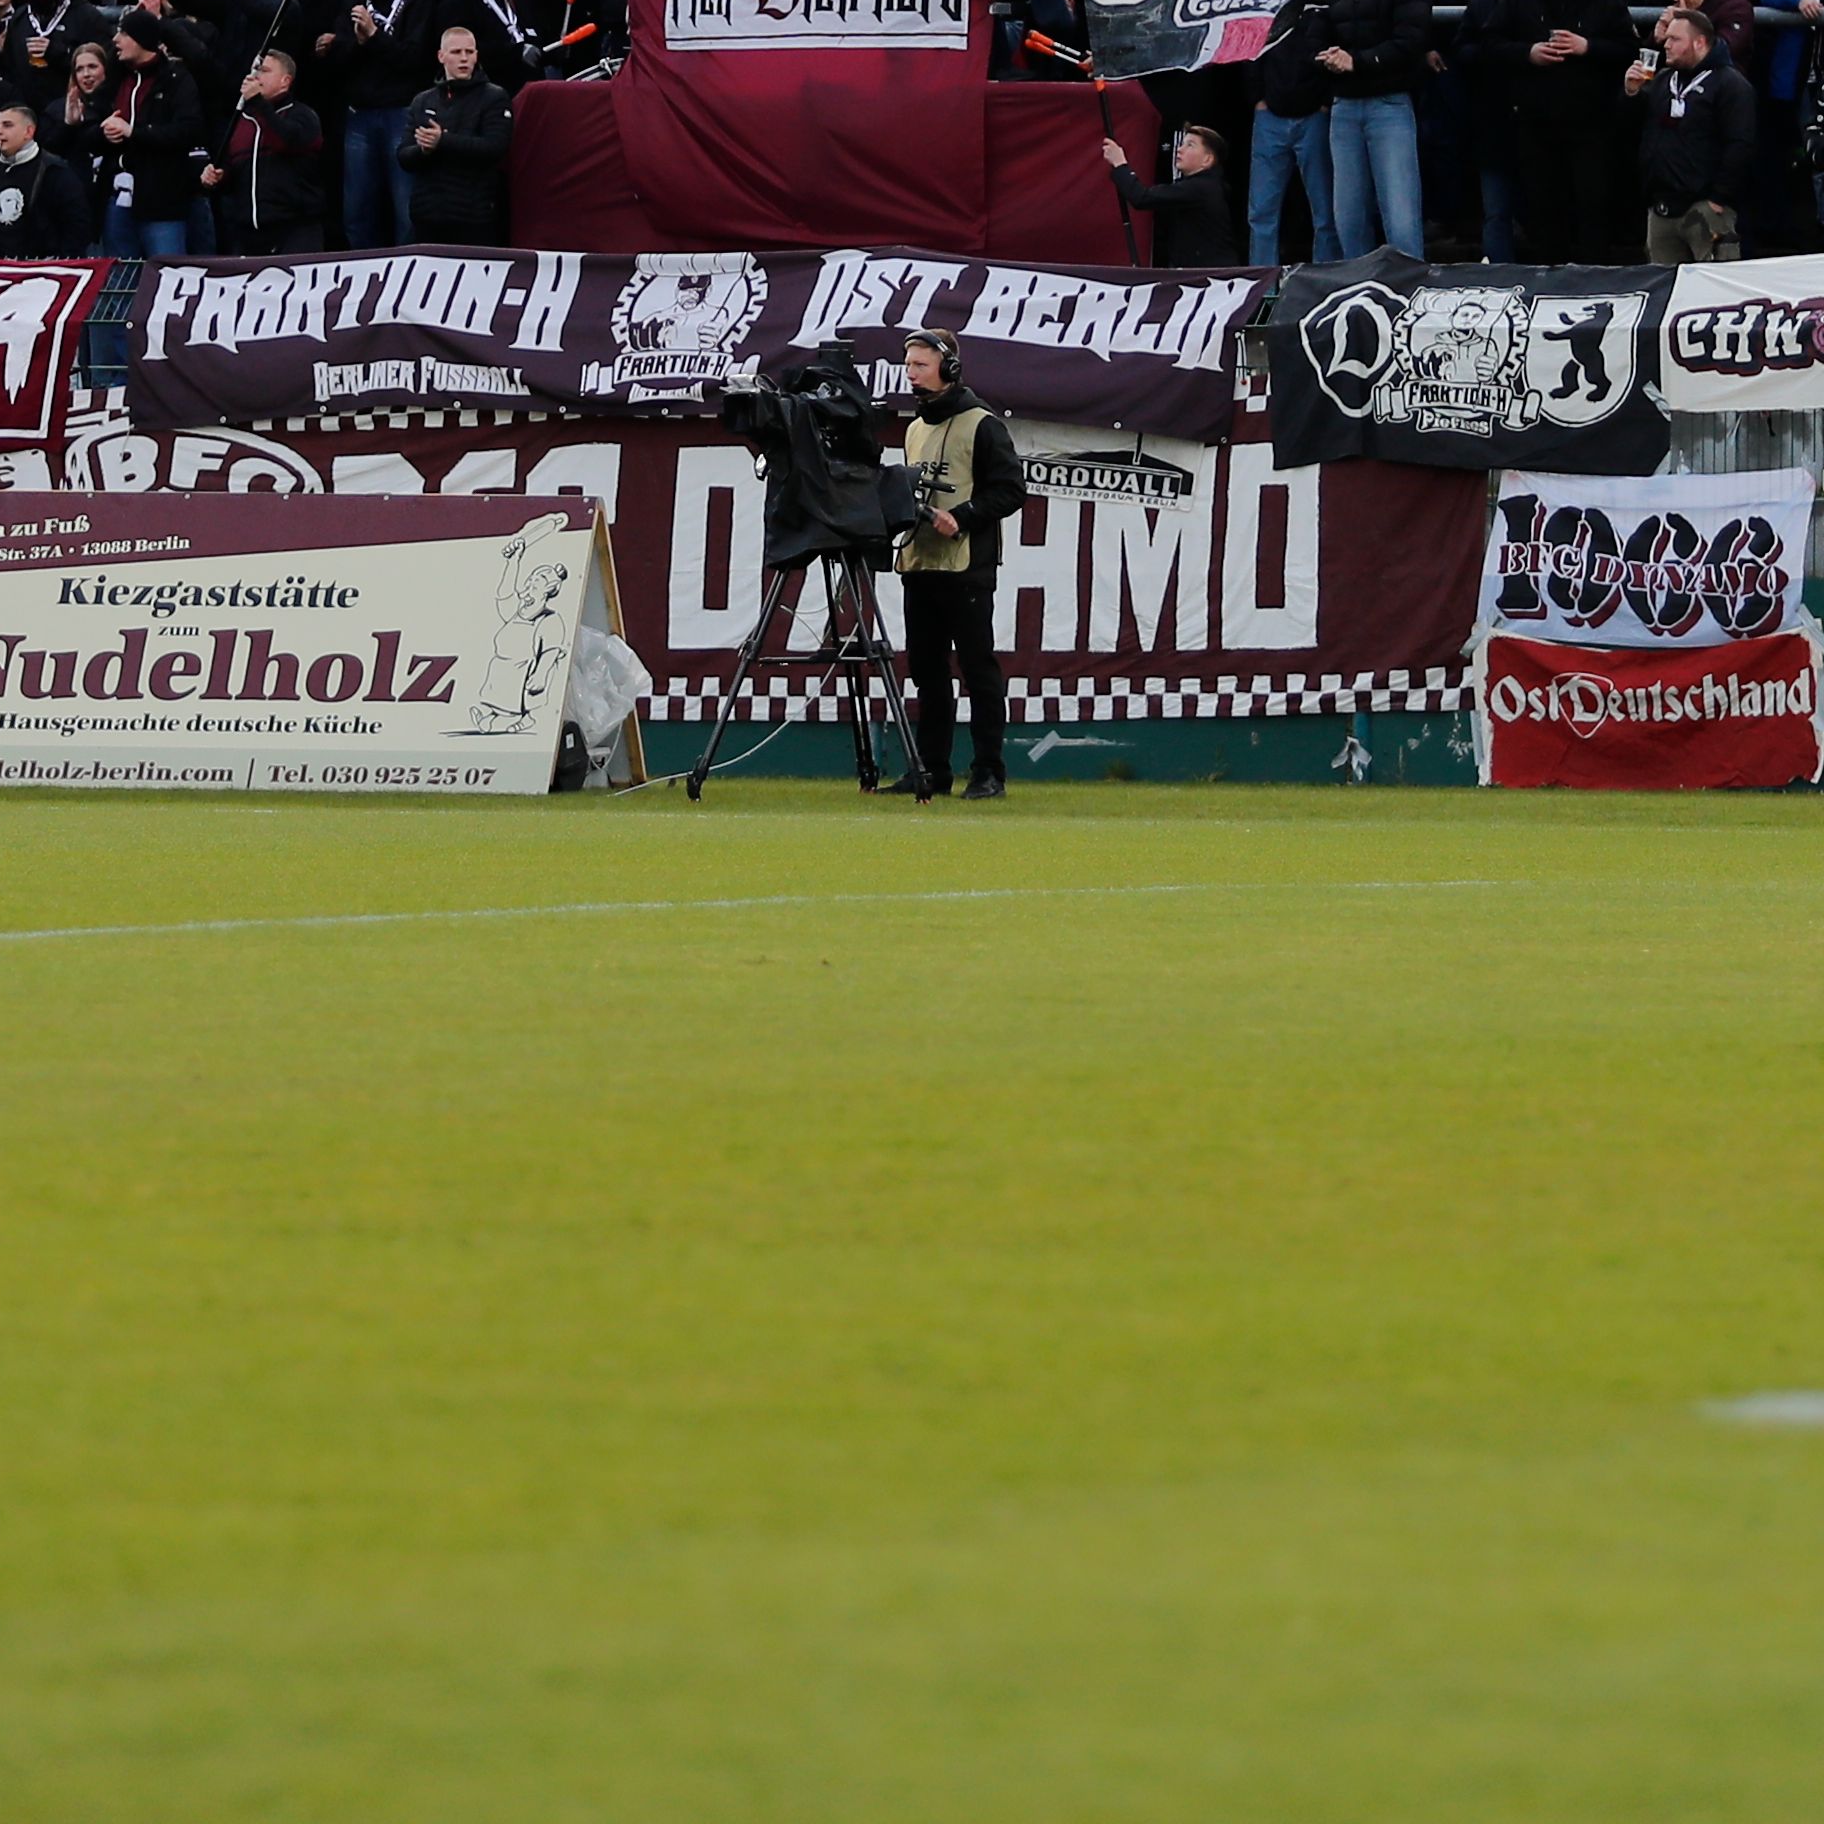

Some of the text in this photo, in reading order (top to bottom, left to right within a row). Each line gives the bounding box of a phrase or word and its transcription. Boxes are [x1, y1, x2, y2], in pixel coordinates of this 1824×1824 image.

[142, 248, 1259, 373] FRAKTION-H OST BERLIN
[617, 354, 730, 382] FRAKTION-H
[1408, 382, 1507, 413] FRAKTION-H
[10, 522, 39, 537] zu
[42, 515, 90, 535] Fuß
[29, 544, 63, 559] 37A
[80, 539, 131, 556] 13088
[134, 536, 191, 553] Berlin
[668, 443, 1321, 653] DAMO
[1497, 542, 1789, 597] BFC DYNAMO
[56, 574, 360, 618] Kiezgaststätte
[157, 625, 200, 637] zum
[185, 713, 297, 734] deutsche
[302, 714, 383, 735] Küche
[267, 763, 315, 784] Tel.
[321, 765, 368, 785] 030
[374, 765, 422, 786] 925
[426, 766, 461, 786] 25
[464, 766, 497, 787] 07
